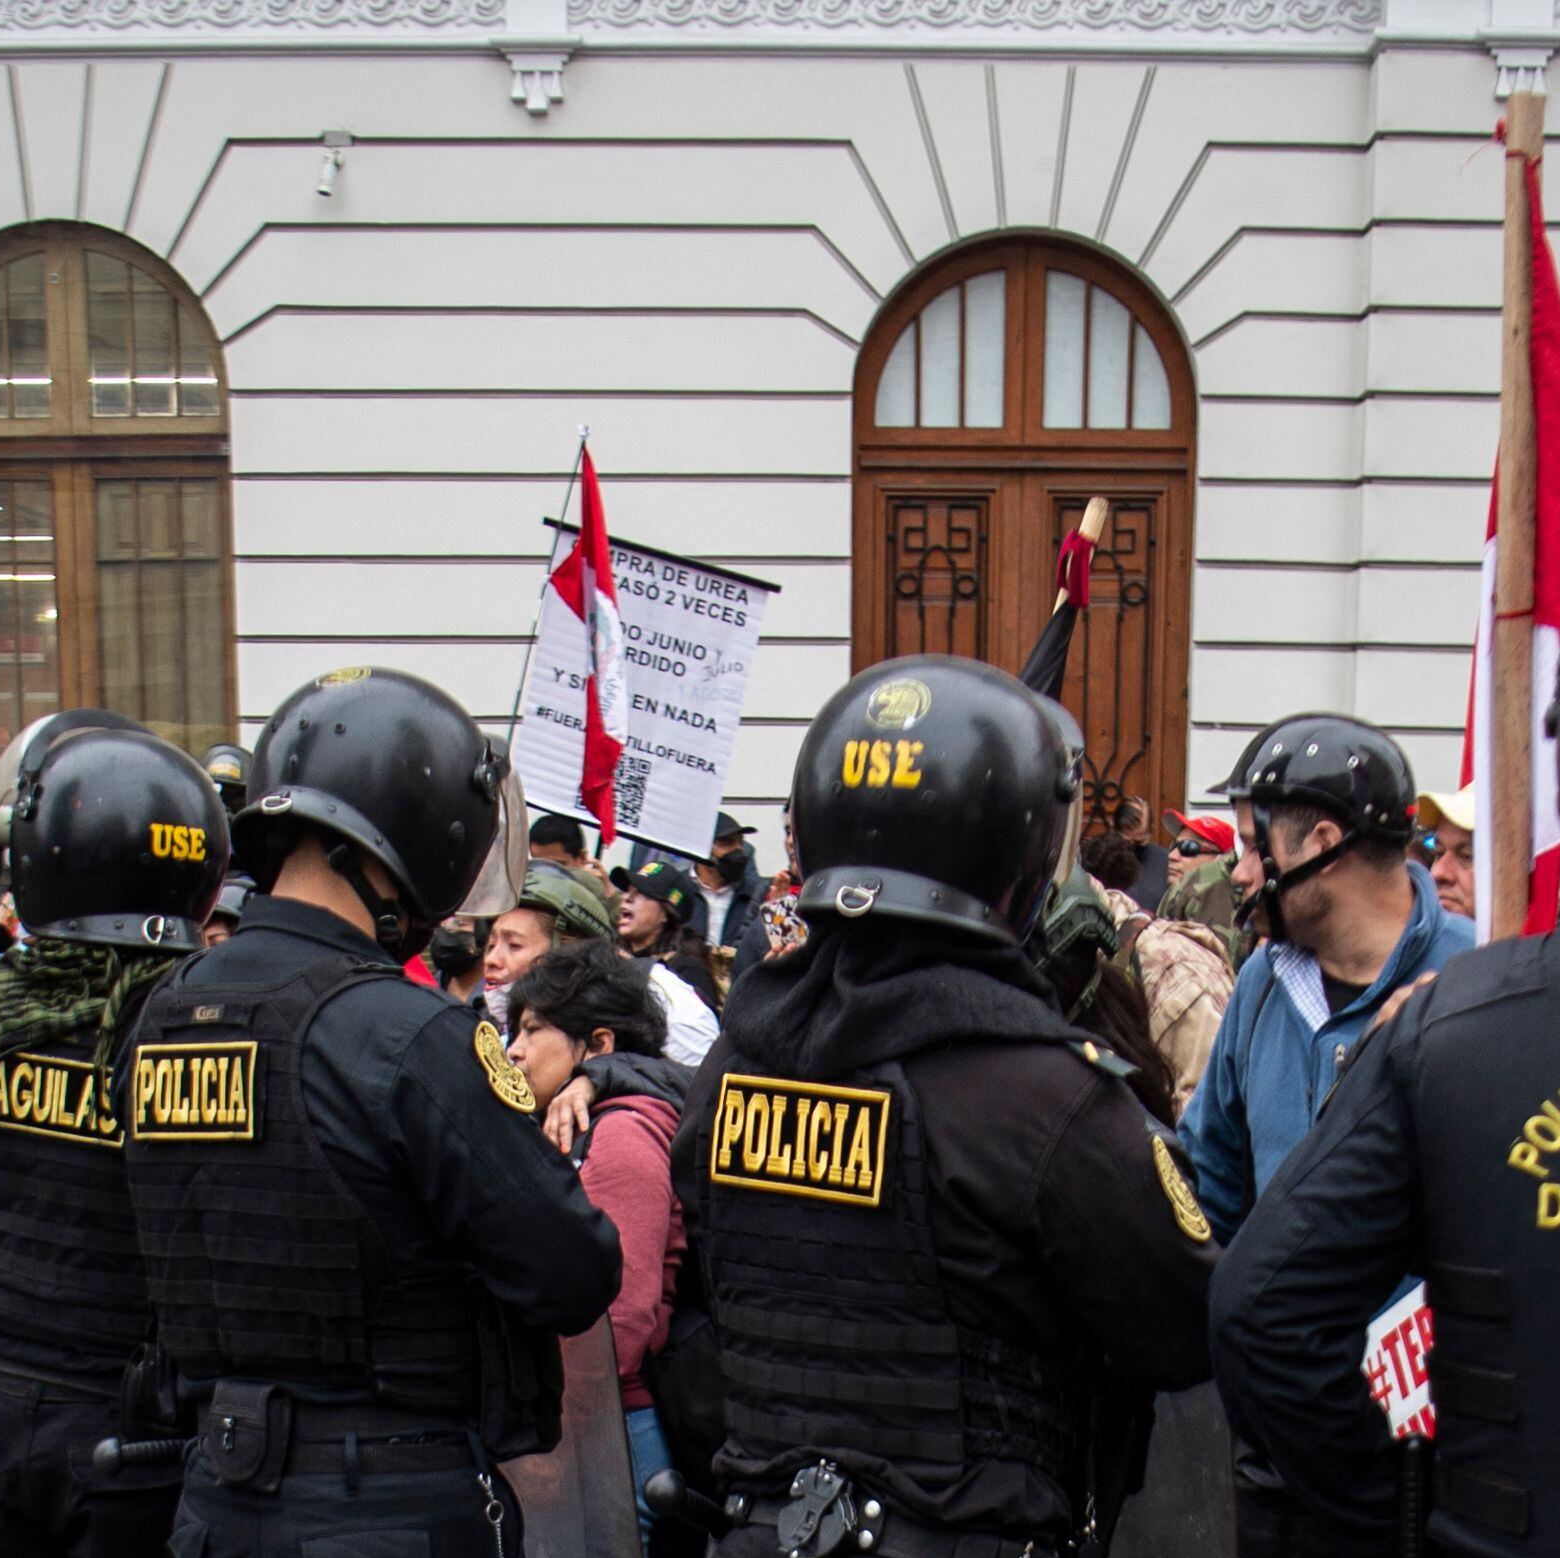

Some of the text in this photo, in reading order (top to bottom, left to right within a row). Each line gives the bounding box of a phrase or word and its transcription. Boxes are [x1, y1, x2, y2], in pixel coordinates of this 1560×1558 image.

[662, 565, 689, 587] DE
[695, 574, 749, 605] UREA
[664, 589, 675, 606] 2
[681, 593, 748, 628] VECES
[625, 645, 687, 677] RDIDO
[647, 631, 707, 661] JUNIO
[553, 667, 565, 683] Y
[631, 693, 658, 715] EN
[664, 703, 718, 734] NADA
[843, 740, 925, 789] USE
[151, 823, 206, 861] USE
[136, 1056, 247, 1125] POLICIA
[718, 1089, 873, 1187] POLICIA
